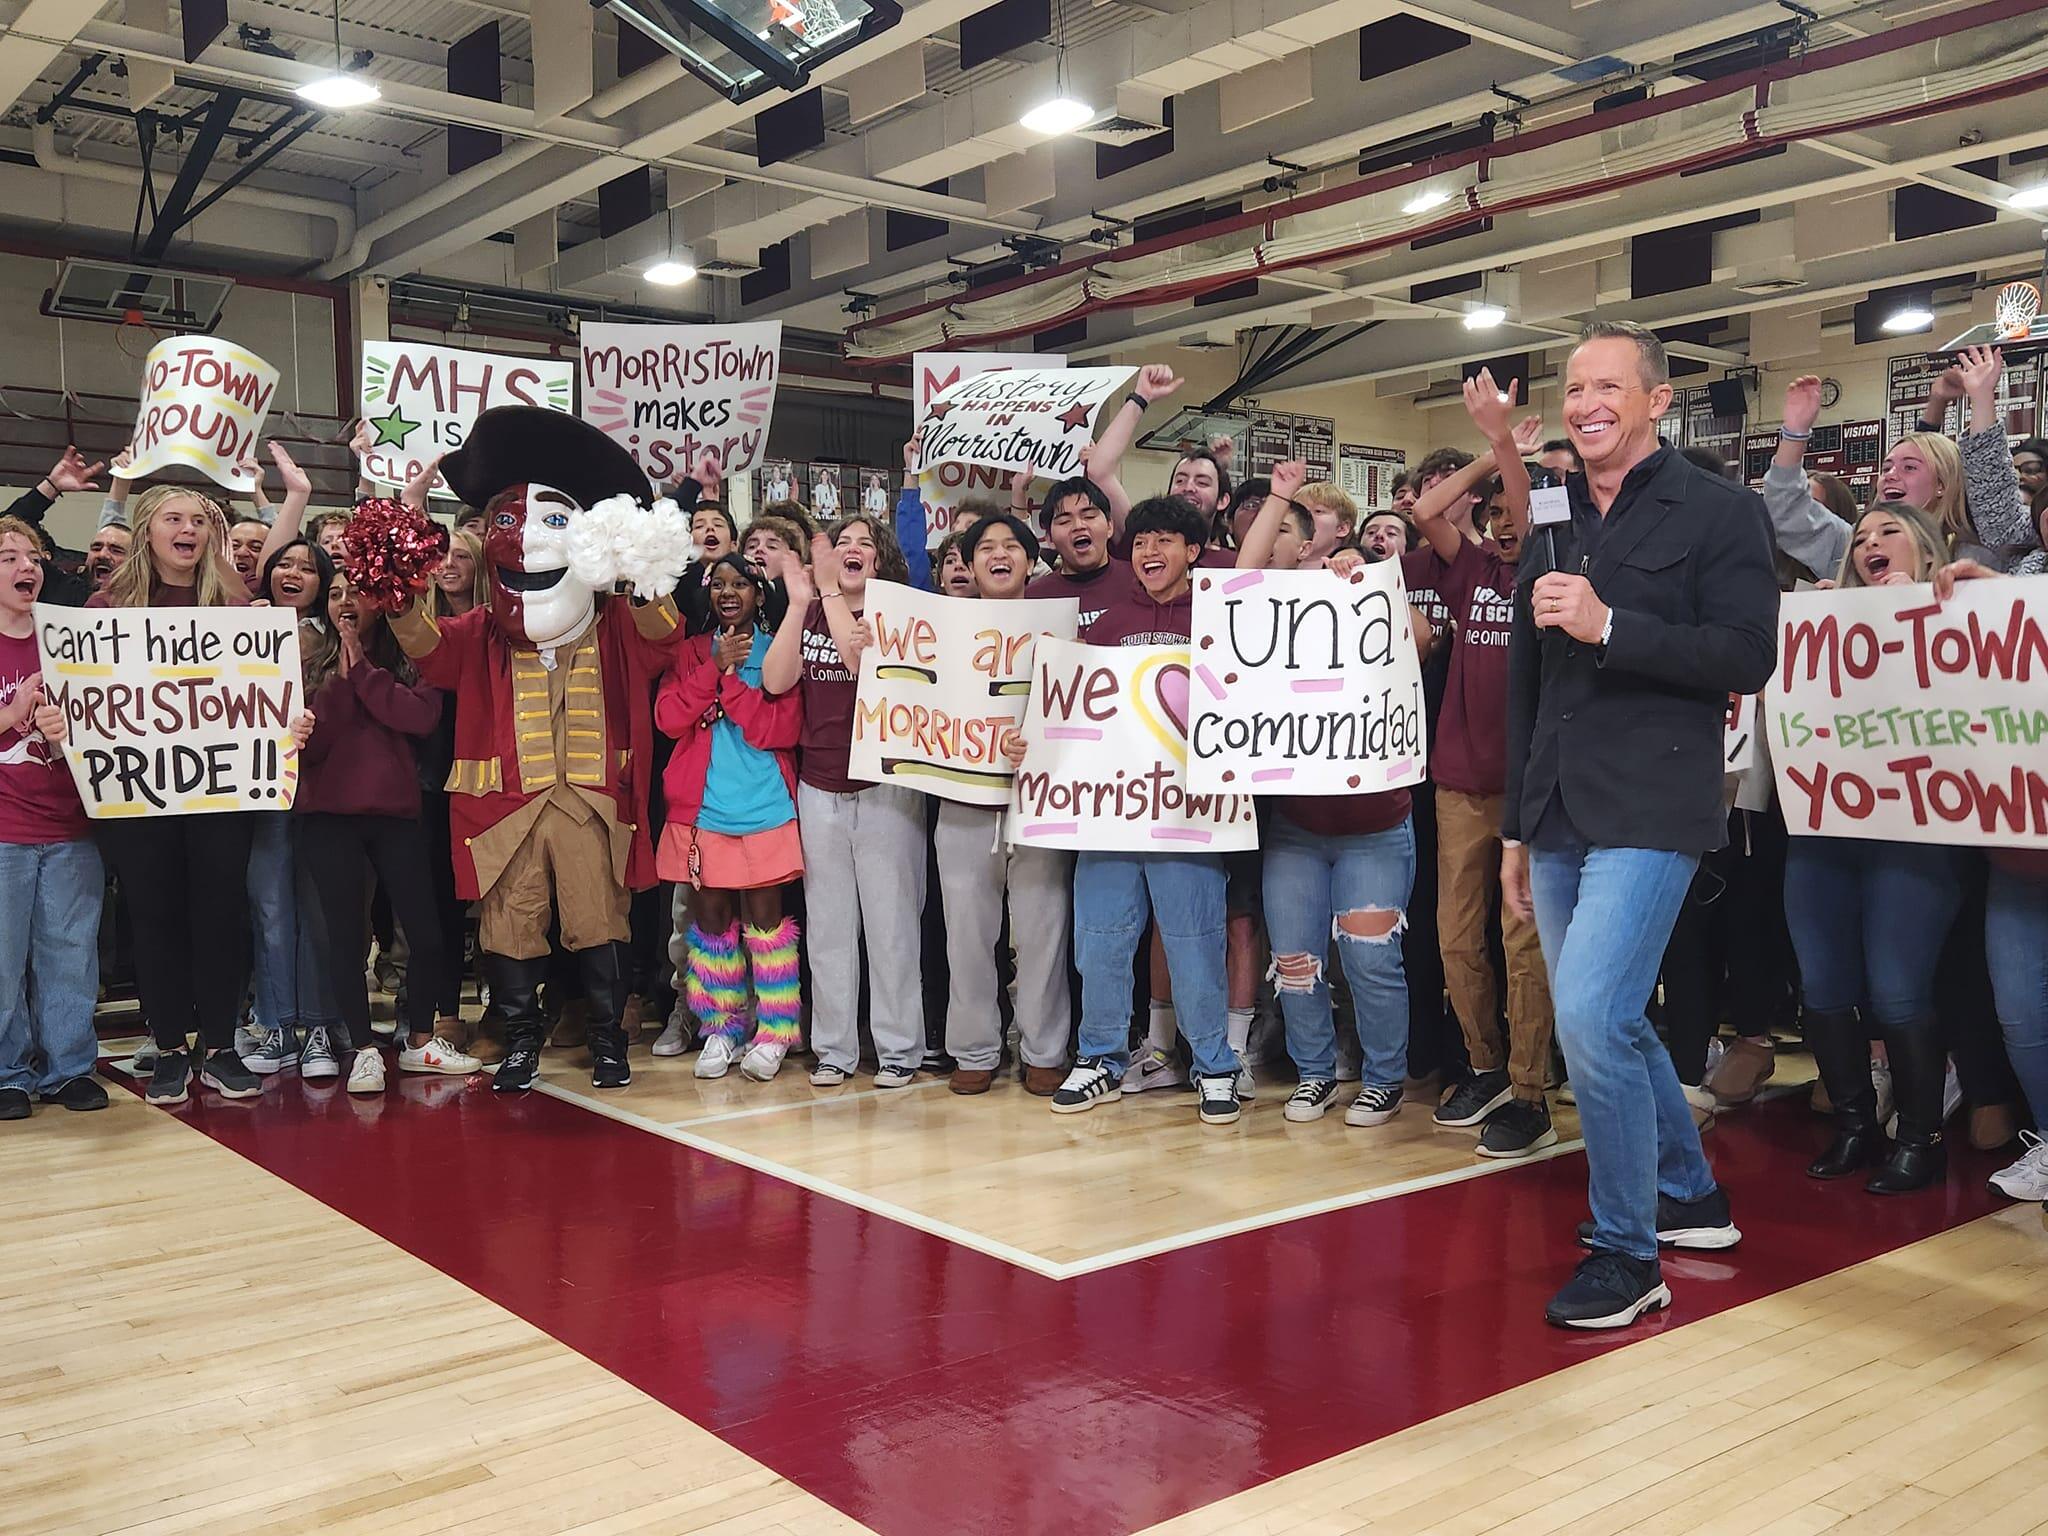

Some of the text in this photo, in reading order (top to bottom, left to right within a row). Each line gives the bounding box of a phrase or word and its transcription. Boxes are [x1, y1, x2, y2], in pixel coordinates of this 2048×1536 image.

[387, 354, 541, 414] MHS
[633, 396, 732, 431] makes
[961, 400, 1056, 413] HAPPENS
[986, 413, 1015, 426] IN
[433, 420, 463, 446] IS
[918, 422, 1080, 475] Morristown
[1747, 436, 1778, 450] COLONIALS
[1844, 424, 1879, 438] VISITOR
[629, 428, 762, 479] istory
[1849, 476, 1871, 486] FOULS
[43, 618, 293, 666] can't hide our
[972, 629, 1056, 678] ar
[46, 677, 293, 746] MORRISTOWN
[1193, 682, 1421, 760] comunidad
